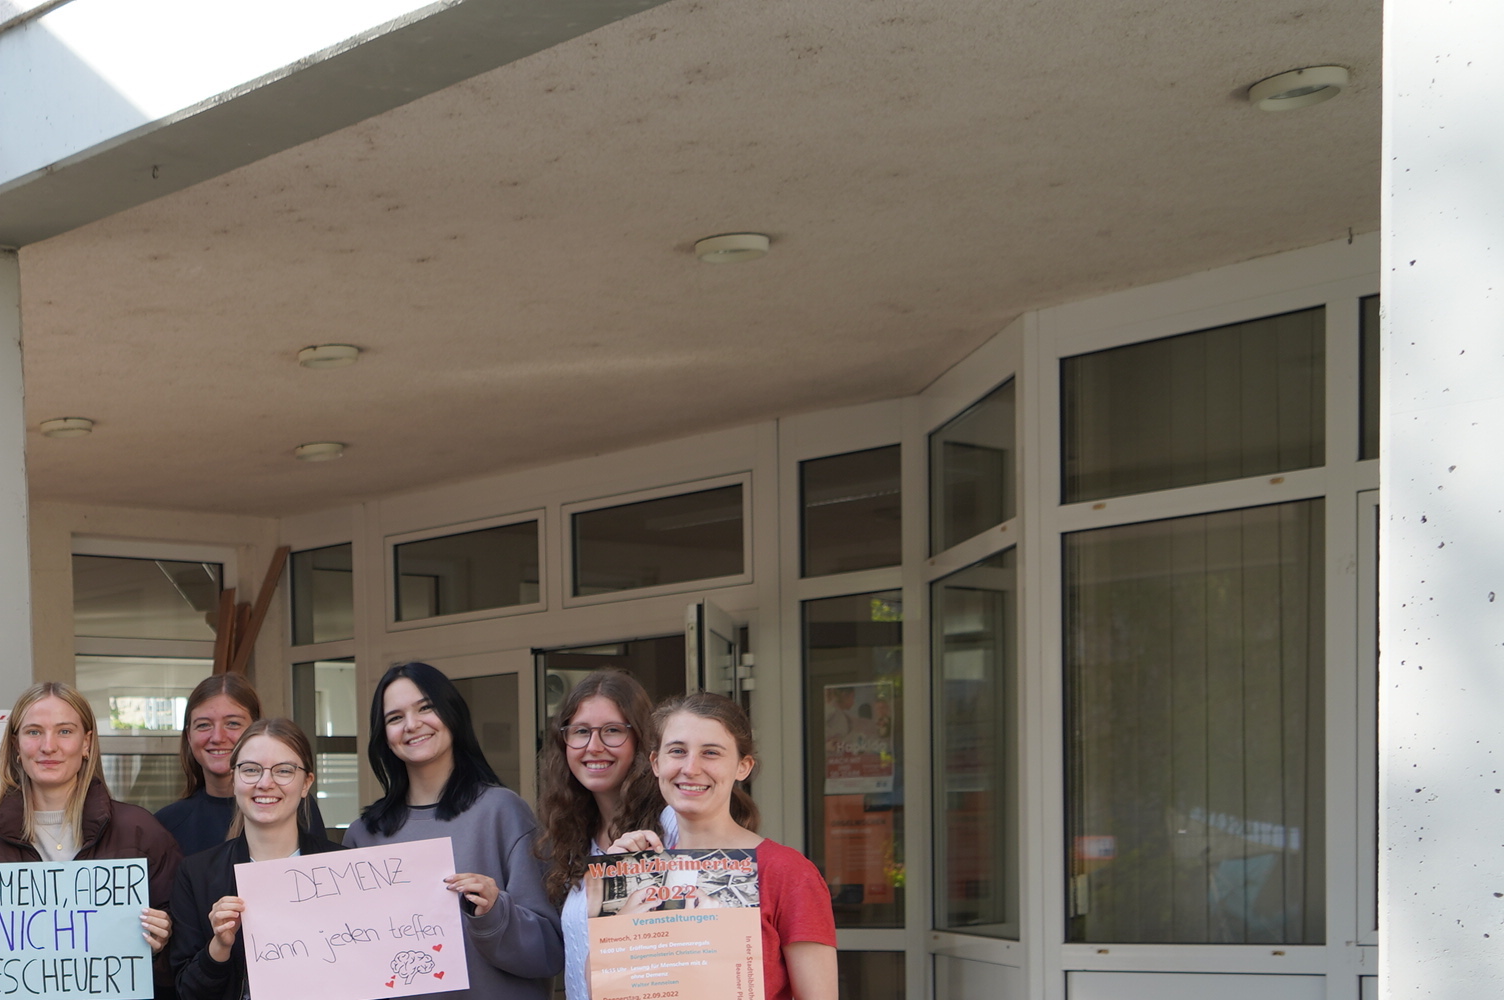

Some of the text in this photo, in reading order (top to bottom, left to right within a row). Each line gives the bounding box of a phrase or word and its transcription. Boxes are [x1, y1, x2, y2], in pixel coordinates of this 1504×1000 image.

[588, 856, 754, 880] Weltalzheimertag
[74, 864, 146, 906] ABER
[285, 858, 411, 902] DEMENZ
[646, 884, 697, 902] 2022
[632, 912, 718, 926] Veranstaltungen:
[251, 914, 444, 963] kann jeden treffen
[600, 931, 670, 944] Mittwoch, 21.09.2022
[630, 944, 657, 952] Eröffnung
[631, 964, 650, 972] Lesung
[642, 991, 679, 1000] 22.09.2022
